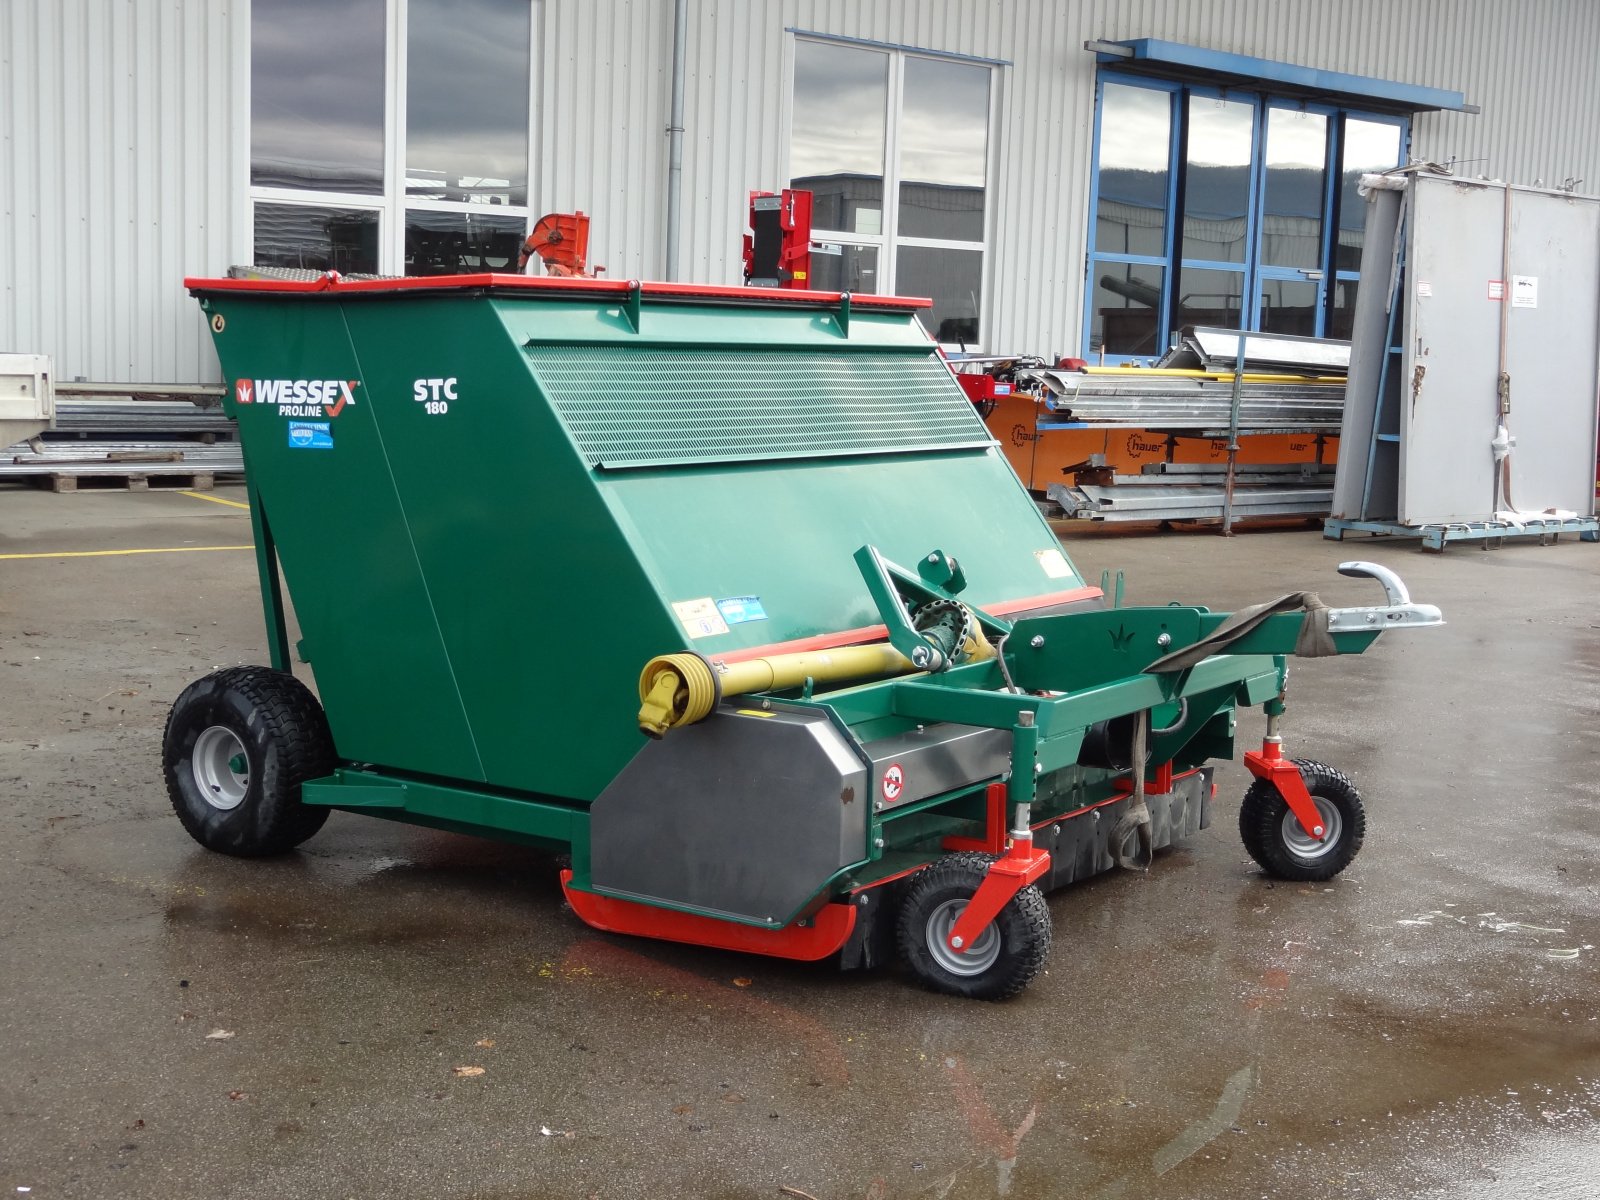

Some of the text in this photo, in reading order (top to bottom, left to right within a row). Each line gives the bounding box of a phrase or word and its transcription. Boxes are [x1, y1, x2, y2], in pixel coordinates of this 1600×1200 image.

[255, 380, 356, 405] WESSEX
[413, 377, 458, 401] STC
[279, 405, 322, 417] PROLINE
[424, 401, 448, 415] 180
[1132, 438, 1162, 452] hauer
